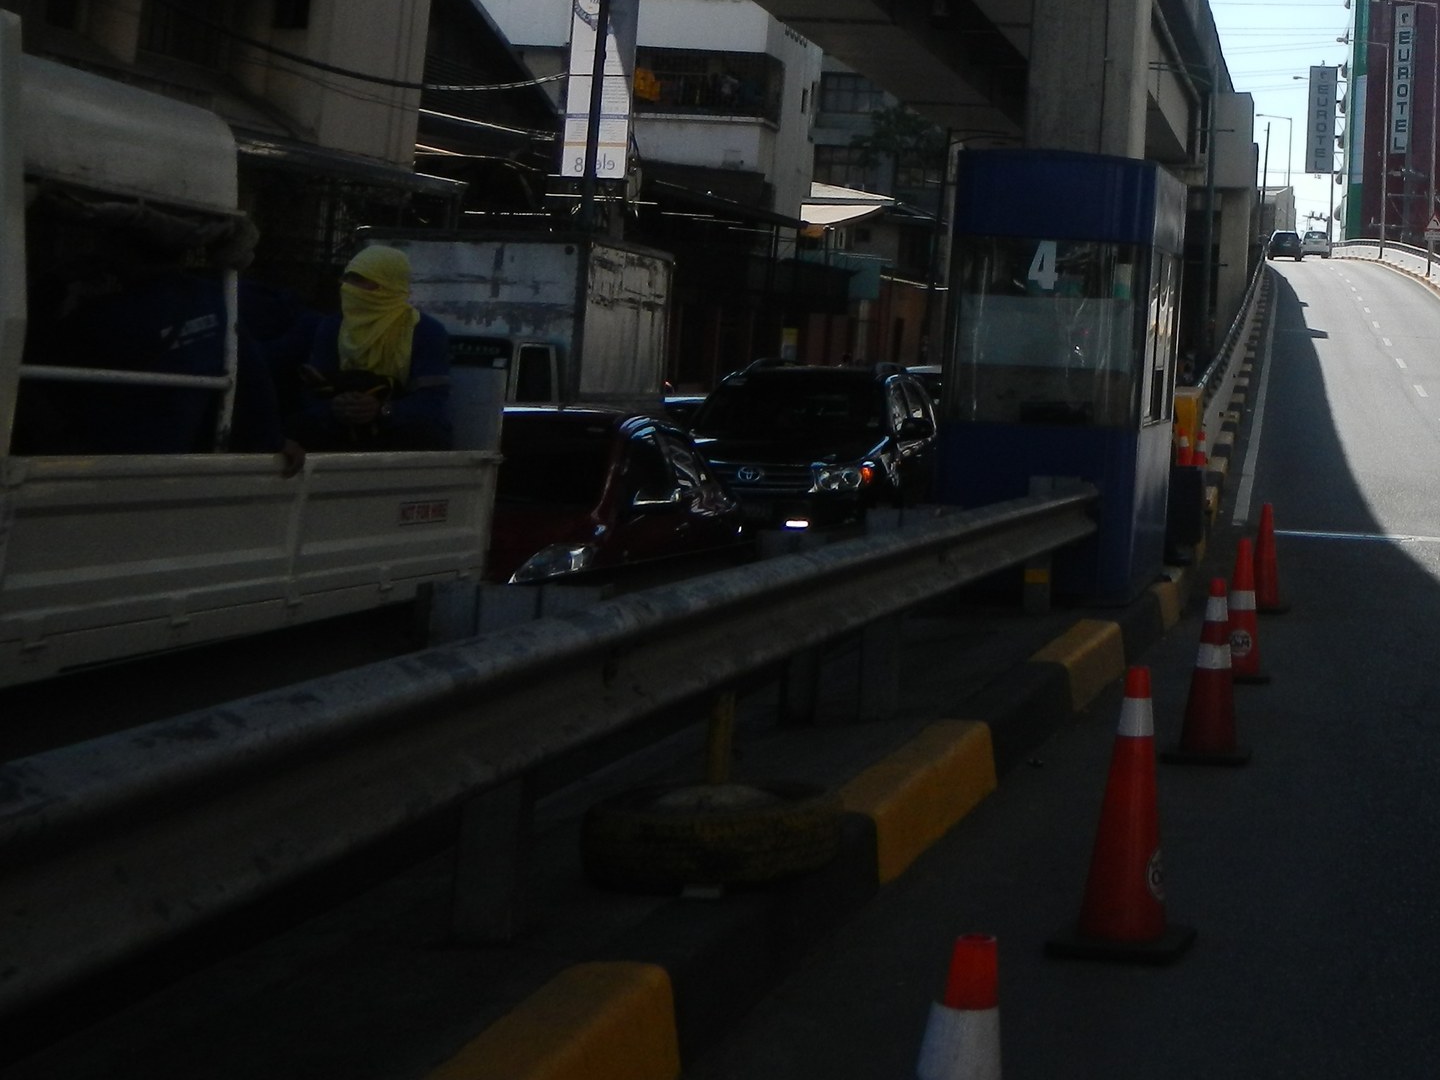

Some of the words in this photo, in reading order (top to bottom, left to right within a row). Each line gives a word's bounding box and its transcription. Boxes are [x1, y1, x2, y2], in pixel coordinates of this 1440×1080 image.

[1314, 84, 1329, 171] EUROTEL
[1393, 30, 1411, 151] EUROTEL
[1028, 240, 1059, 290] 4
